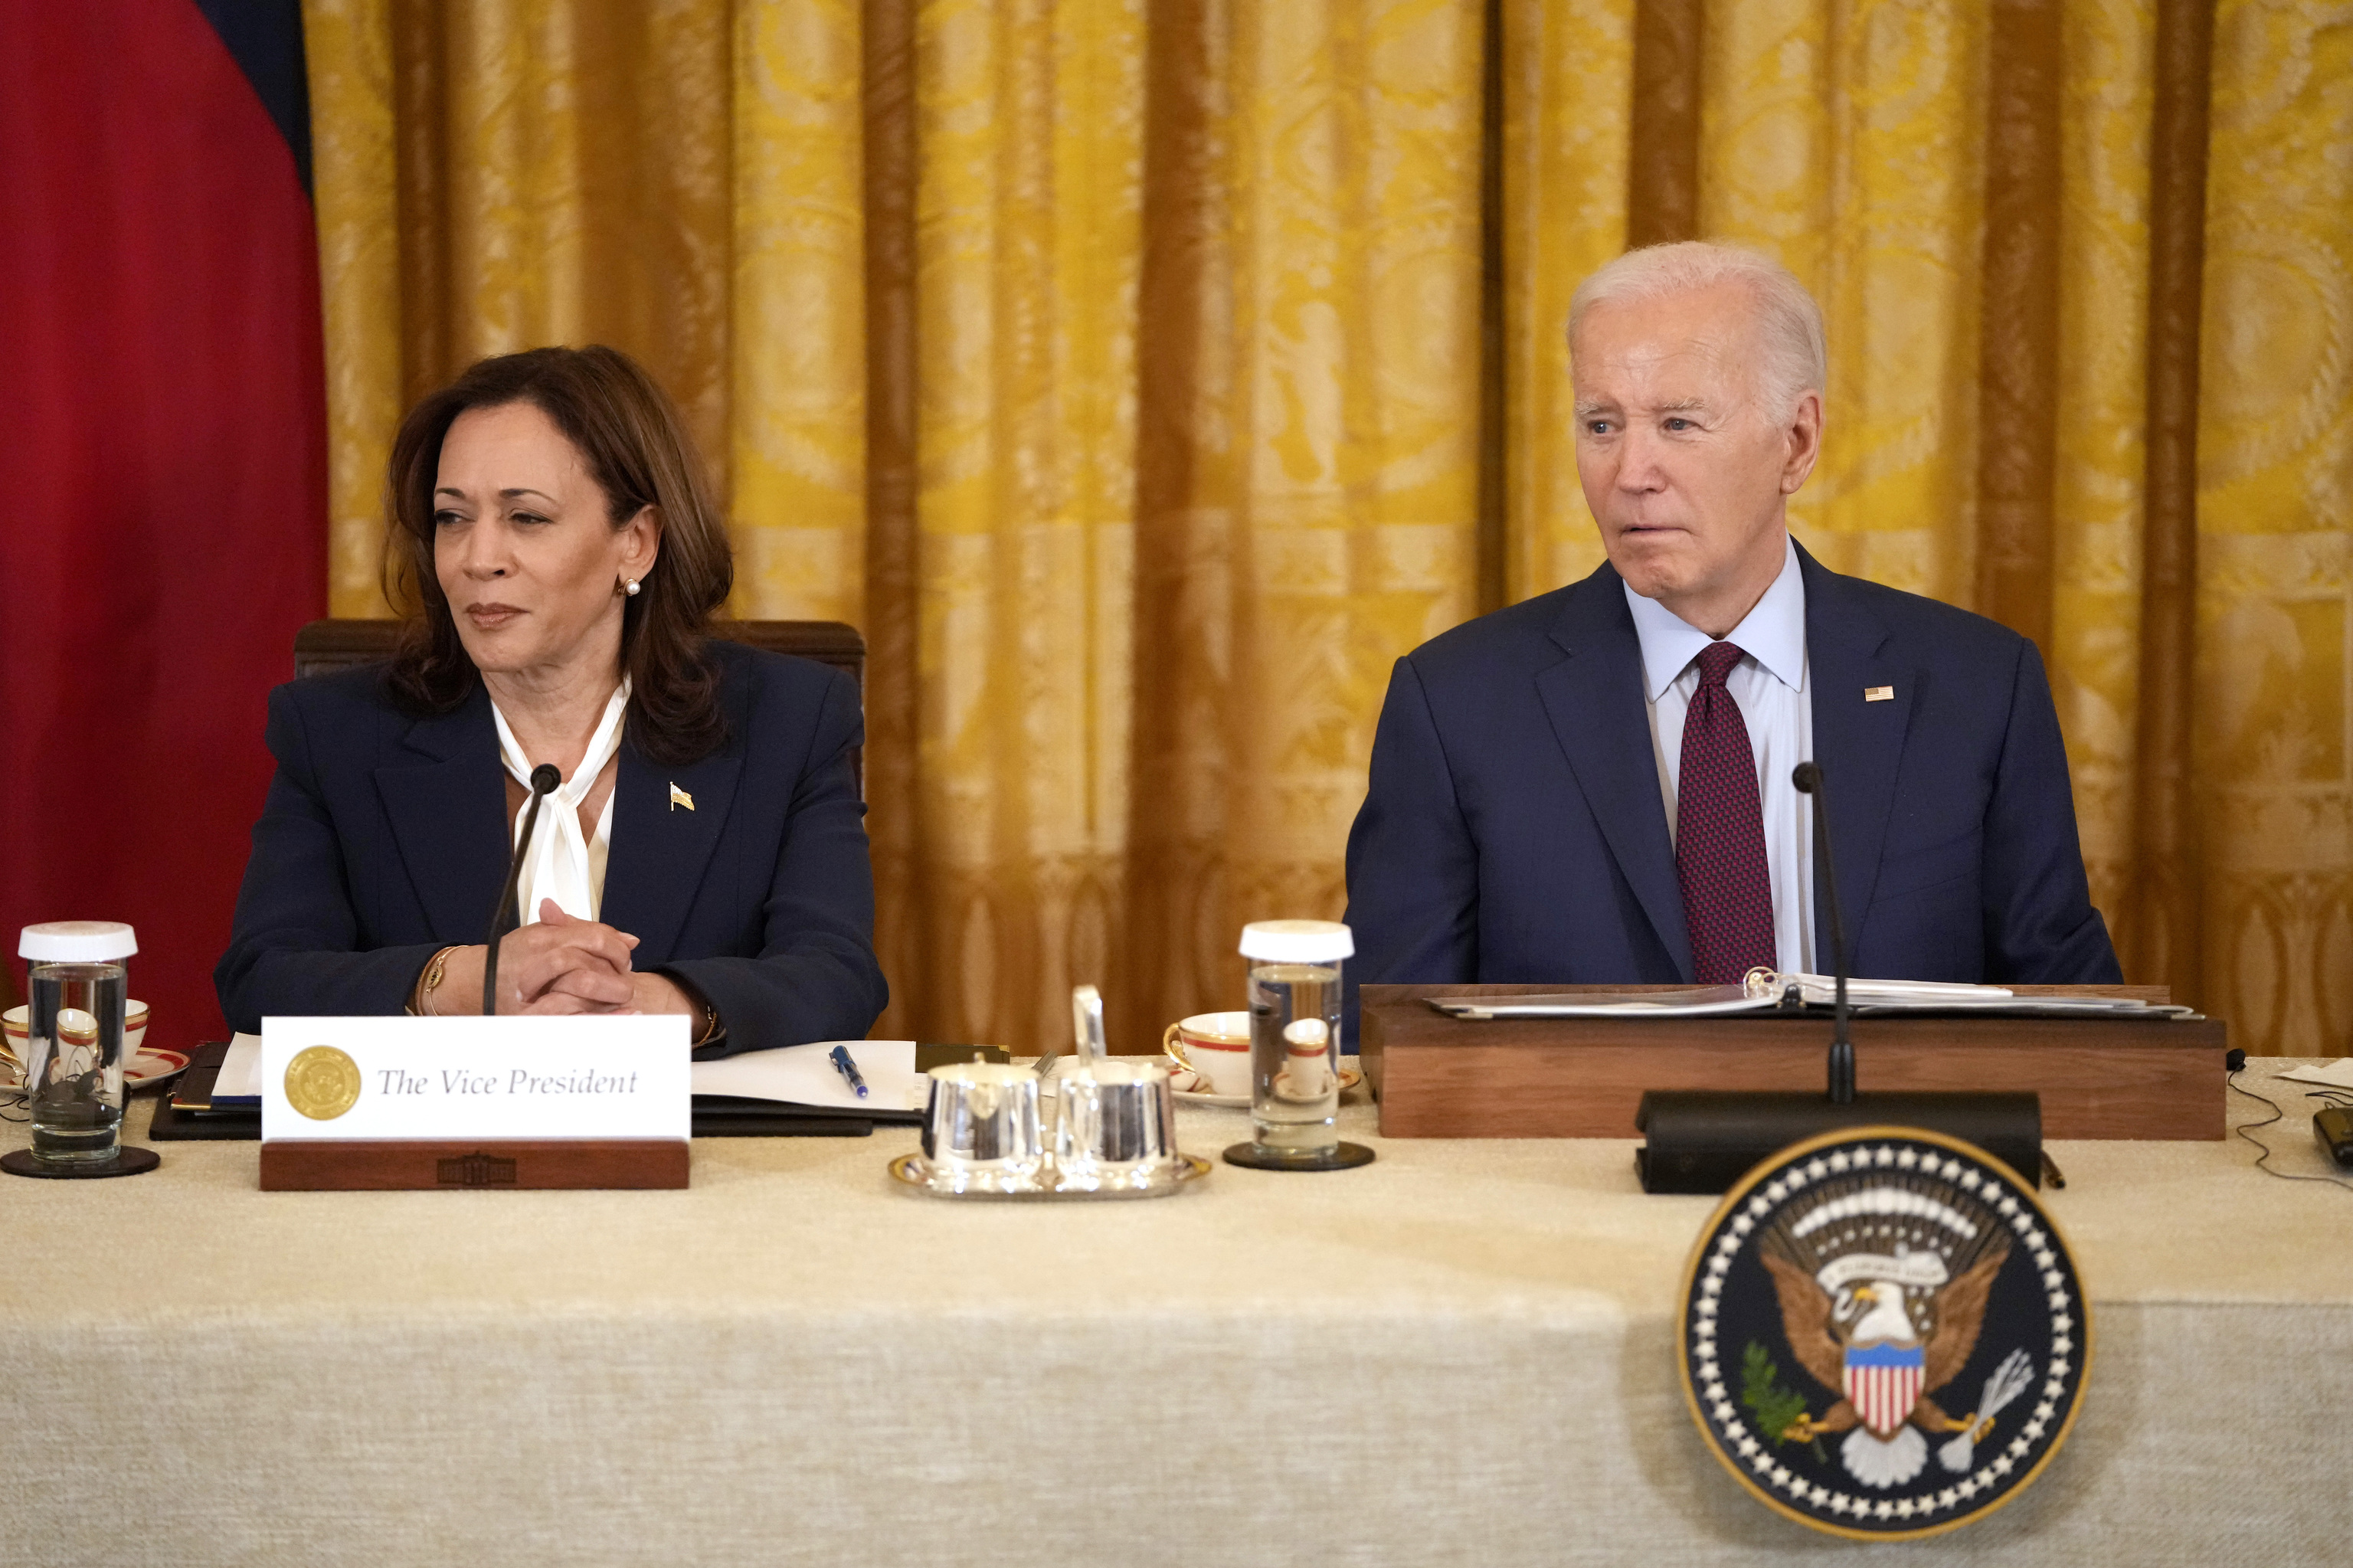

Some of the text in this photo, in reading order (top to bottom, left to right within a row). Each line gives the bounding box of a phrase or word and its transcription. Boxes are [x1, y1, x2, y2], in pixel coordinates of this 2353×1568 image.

[378, 1069, 637, 1095] The Vice President
